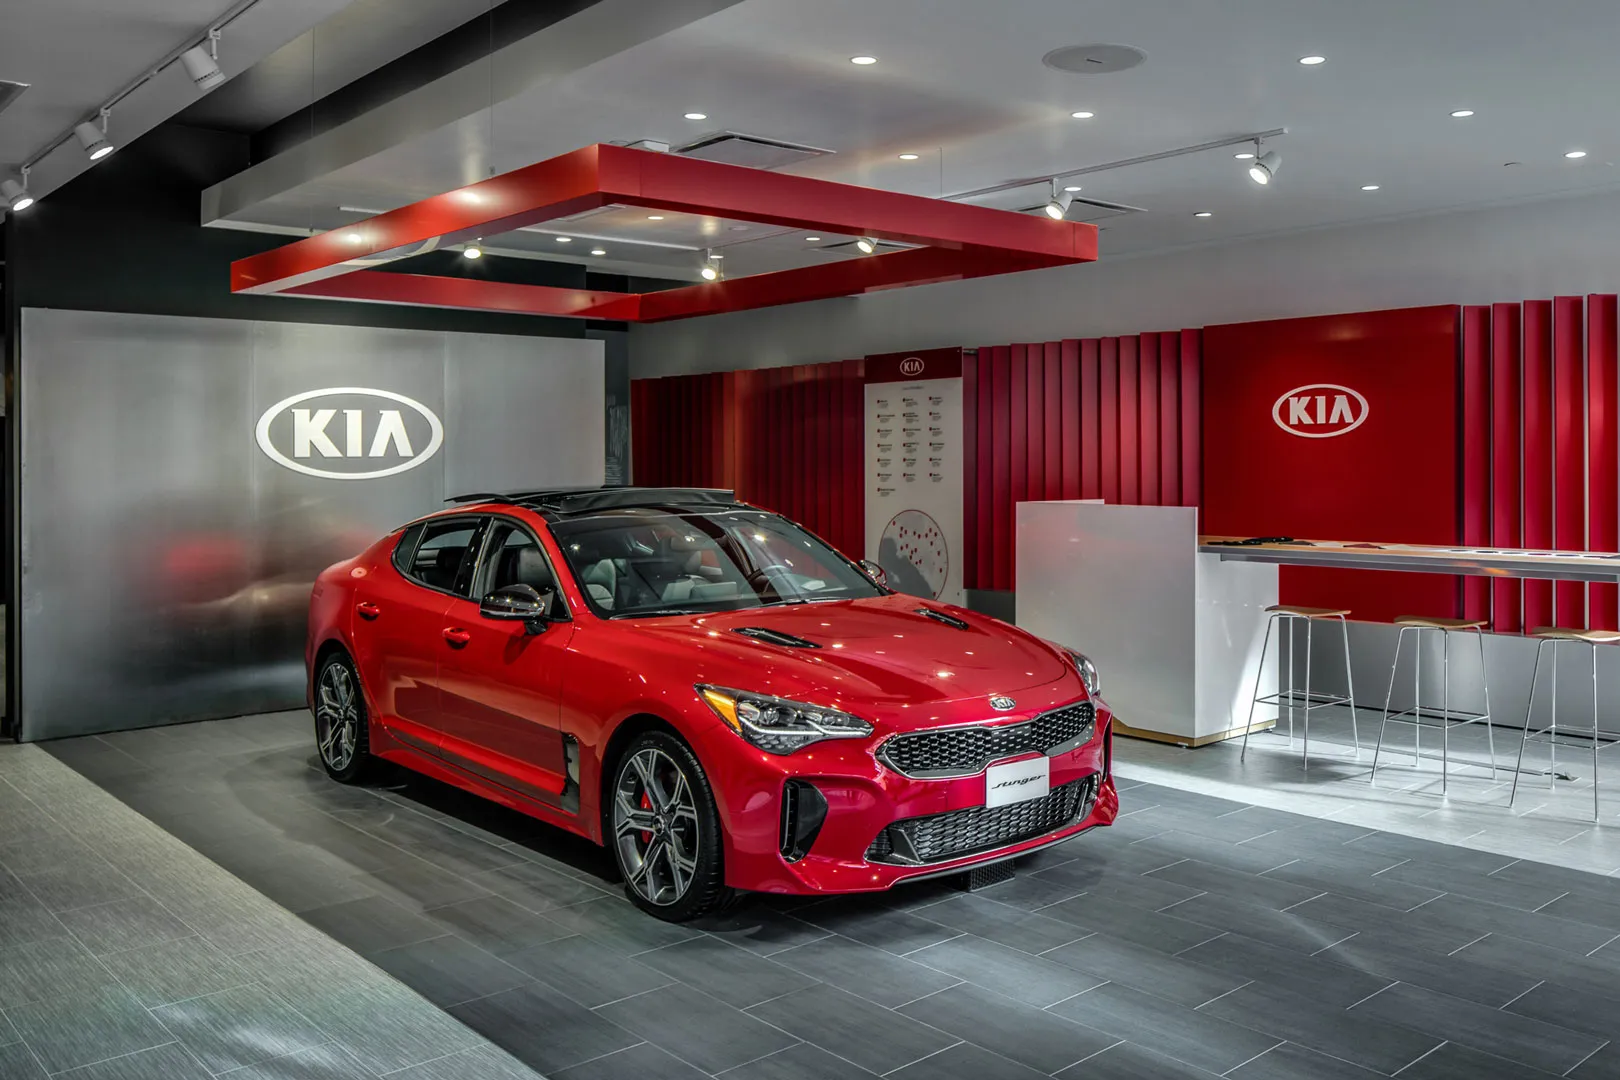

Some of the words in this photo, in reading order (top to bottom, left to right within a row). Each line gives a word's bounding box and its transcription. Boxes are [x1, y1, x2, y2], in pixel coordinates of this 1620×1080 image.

[904, 361, 921, 372] KIA
[1288, 395, 1354, 425] KIA
[291, 409, 414, 458] KIA
[993, 698, 1015, 708] KIA
